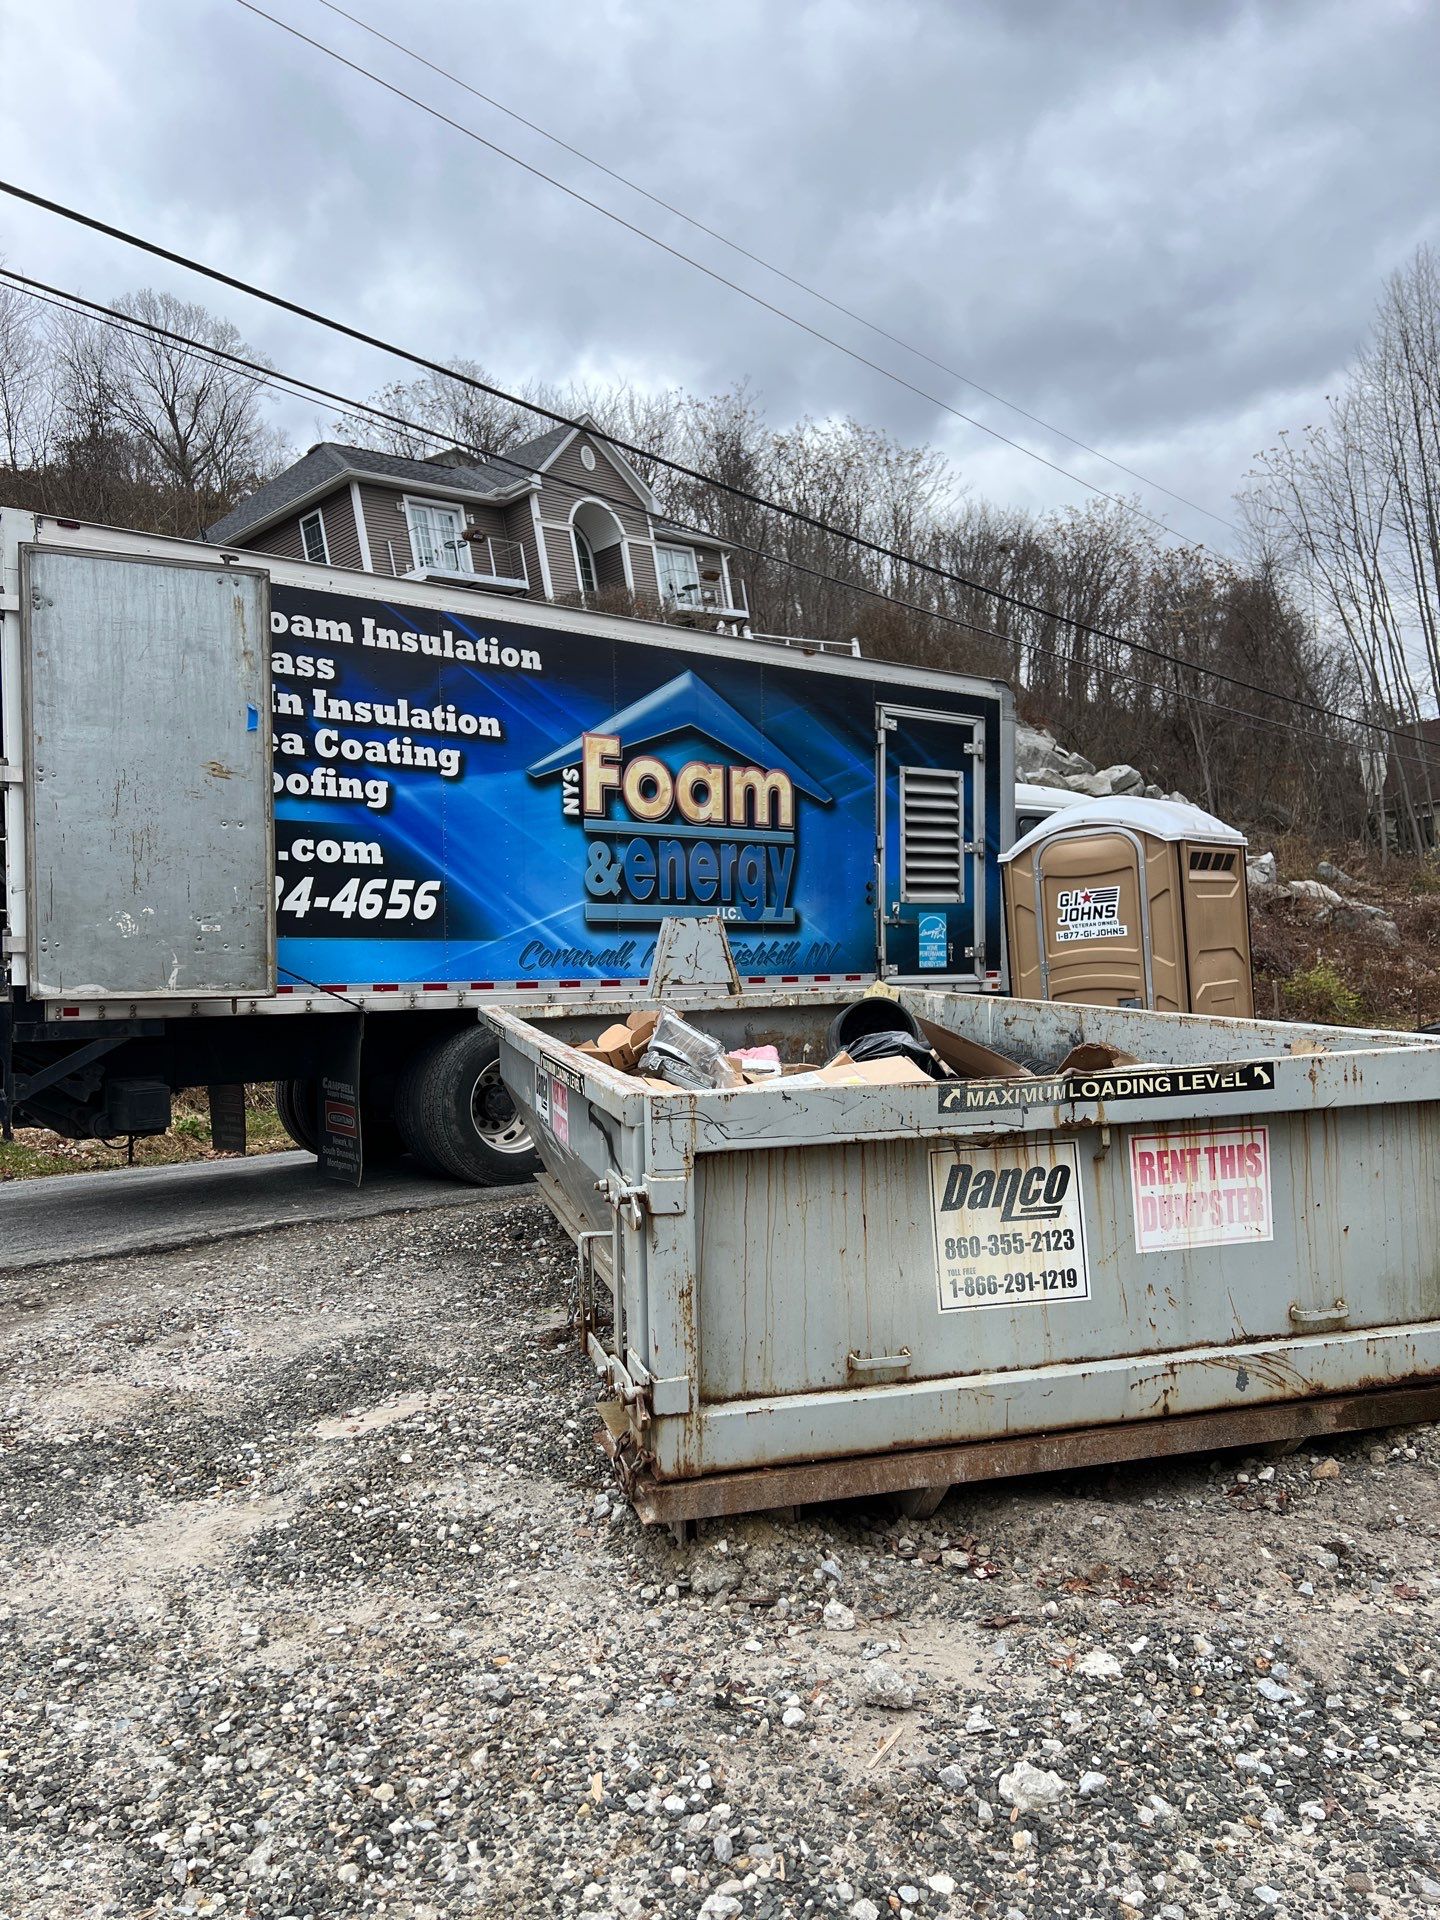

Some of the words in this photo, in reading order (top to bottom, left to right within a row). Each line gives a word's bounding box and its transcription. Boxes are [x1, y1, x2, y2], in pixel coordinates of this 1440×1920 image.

[361, 617, 542, 671] Insulation
[312, 688, 501, 738] Insulation
[314, 728, 460, 777] Coating
[562, 769, 580, 816] NYS
[582, 731, 795, 830] Foam
[277, 838, 384, 865] .com
[584, 841, 621, 896] &
[624, 837, 796, 922] energy
[1060, 892, 1081, 908] G.I.
[1060, 904, 1116, 922] JOHNS
[518, 940, 637, 972] Cornwall,
[803, 941, 842, 968] NY
[966, 1085, 1066, 1107] MAXIMUM
[1068, 1075, 1171, 1098] LOADING
[1179, 1071, 1247, 1090] LEVEL
[1138, 1147, 1200, 1187] RENT
[1204, 1142, 1263, 1181] THIS
[940, 1164, 1071, 1223] Danco
[1142, 1186, 1264, 1233] DUMPSTER
[944, 1229, 1075, 1260] 860-355-2123
[947, 1268, 960, 1276] TOLL
[962, 1267, 977, 1275] FREE
[950, 1268, 1078, 1299] 1-866-291-1219
